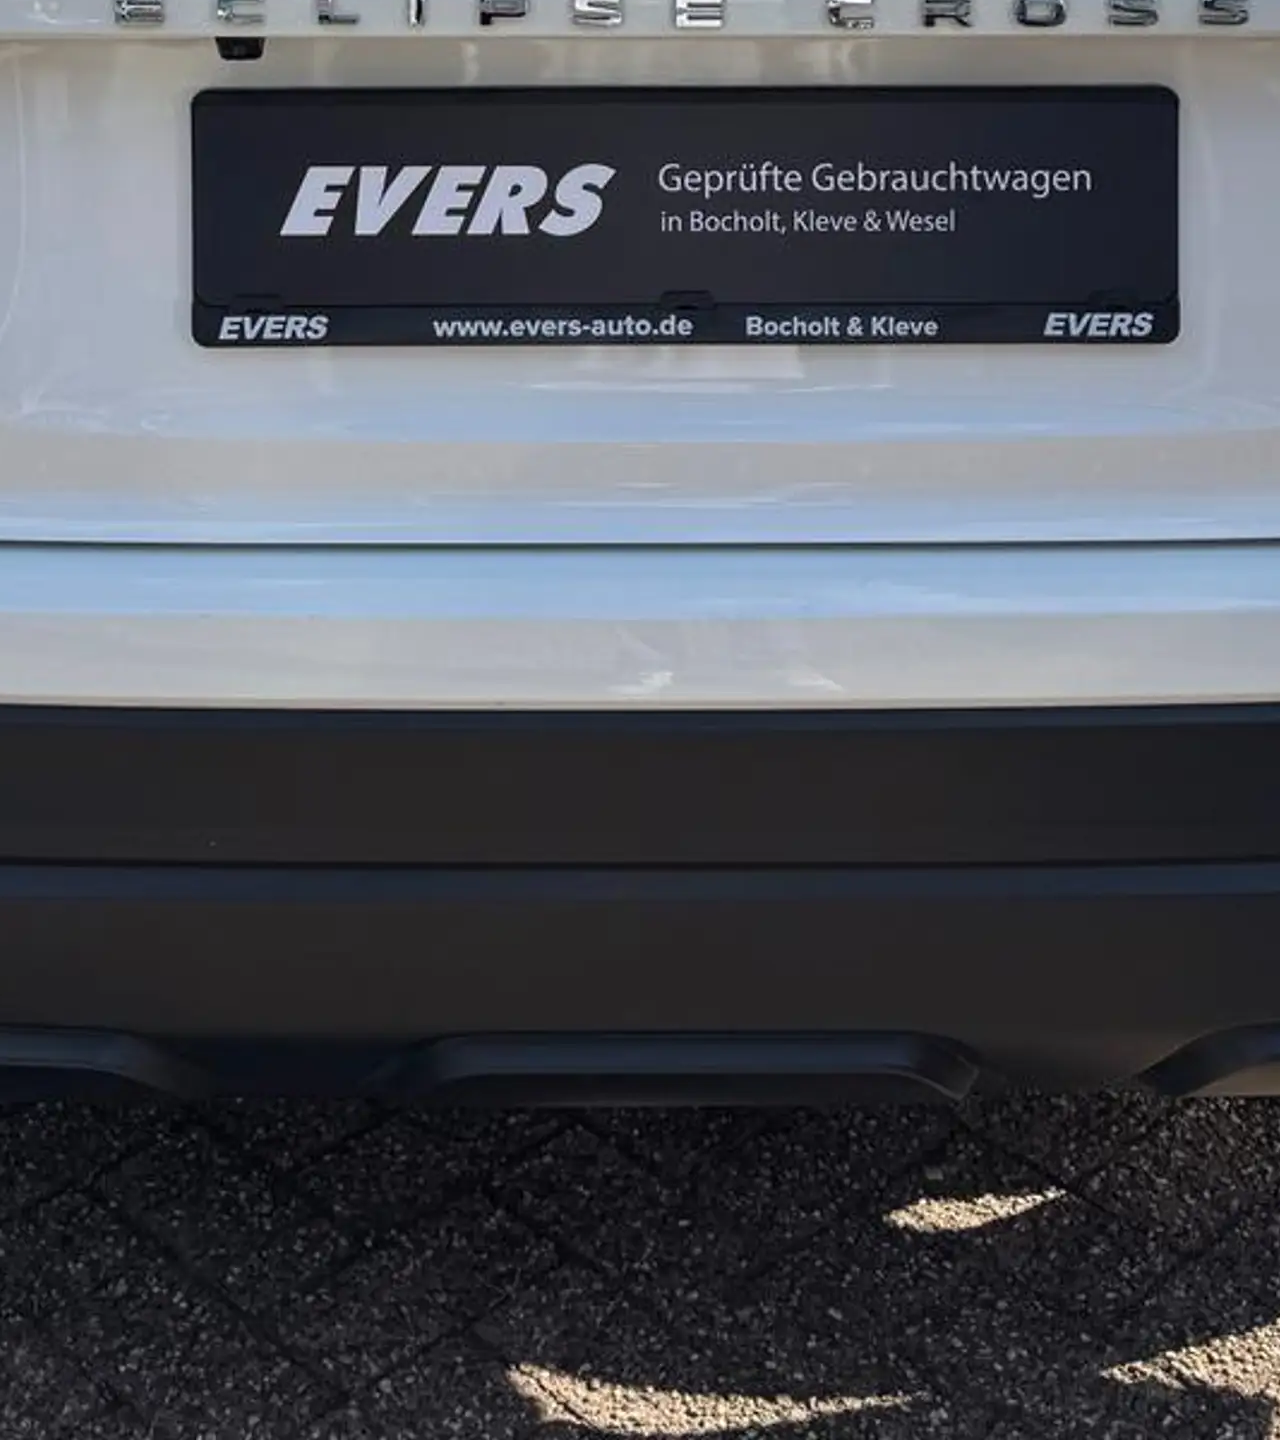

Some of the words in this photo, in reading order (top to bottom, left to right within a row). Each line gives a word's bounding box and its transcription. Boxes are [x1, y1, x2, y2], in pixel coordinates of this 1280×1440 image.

[658, 161, 803, 198] Geprüfte
[812, 161, 1092, 198] Gebrauchtwagen
[280, 163, 617, 237] EVERS
[660, 210, 682, 232] in
[690, 210, 787, 234] Bocholt,
[793, 210, 857, 232] Kleve
[864, 211, 882, 232] &
[886, 210, 956, 232] Wesel
[219, 315, 330, 340] EVERS
[432, 315, 693, 338] www.evers-auto.de
[746, 315, 841, 337] Bocholt
[847, 316, 864, 337] &
[871, 315, 939, 337] Kleve
[1043, 312, 1155, 337] EVERS
